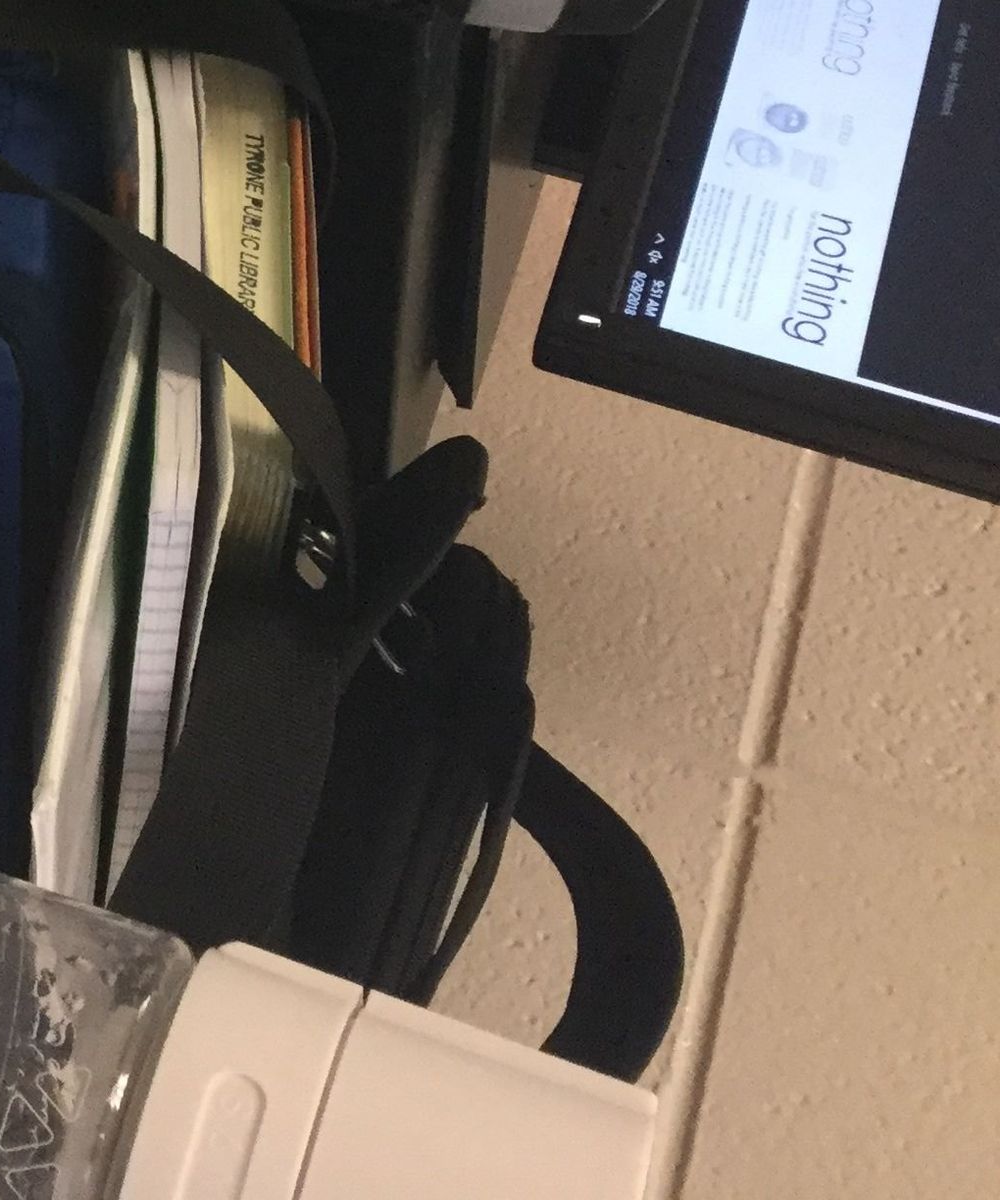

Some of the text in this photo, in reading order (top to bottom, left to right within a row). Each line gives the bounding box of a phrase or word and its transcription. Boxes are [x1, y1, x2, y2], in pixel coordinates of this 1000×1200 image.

[237, 133, 266, 316] TYRONE PUBLIC LIBRAR
[624, 270, 648, 317] 8/29/2018
[644, 279, 665, 318] 9:51 AM
[781, 213, 857, 347] nothing
